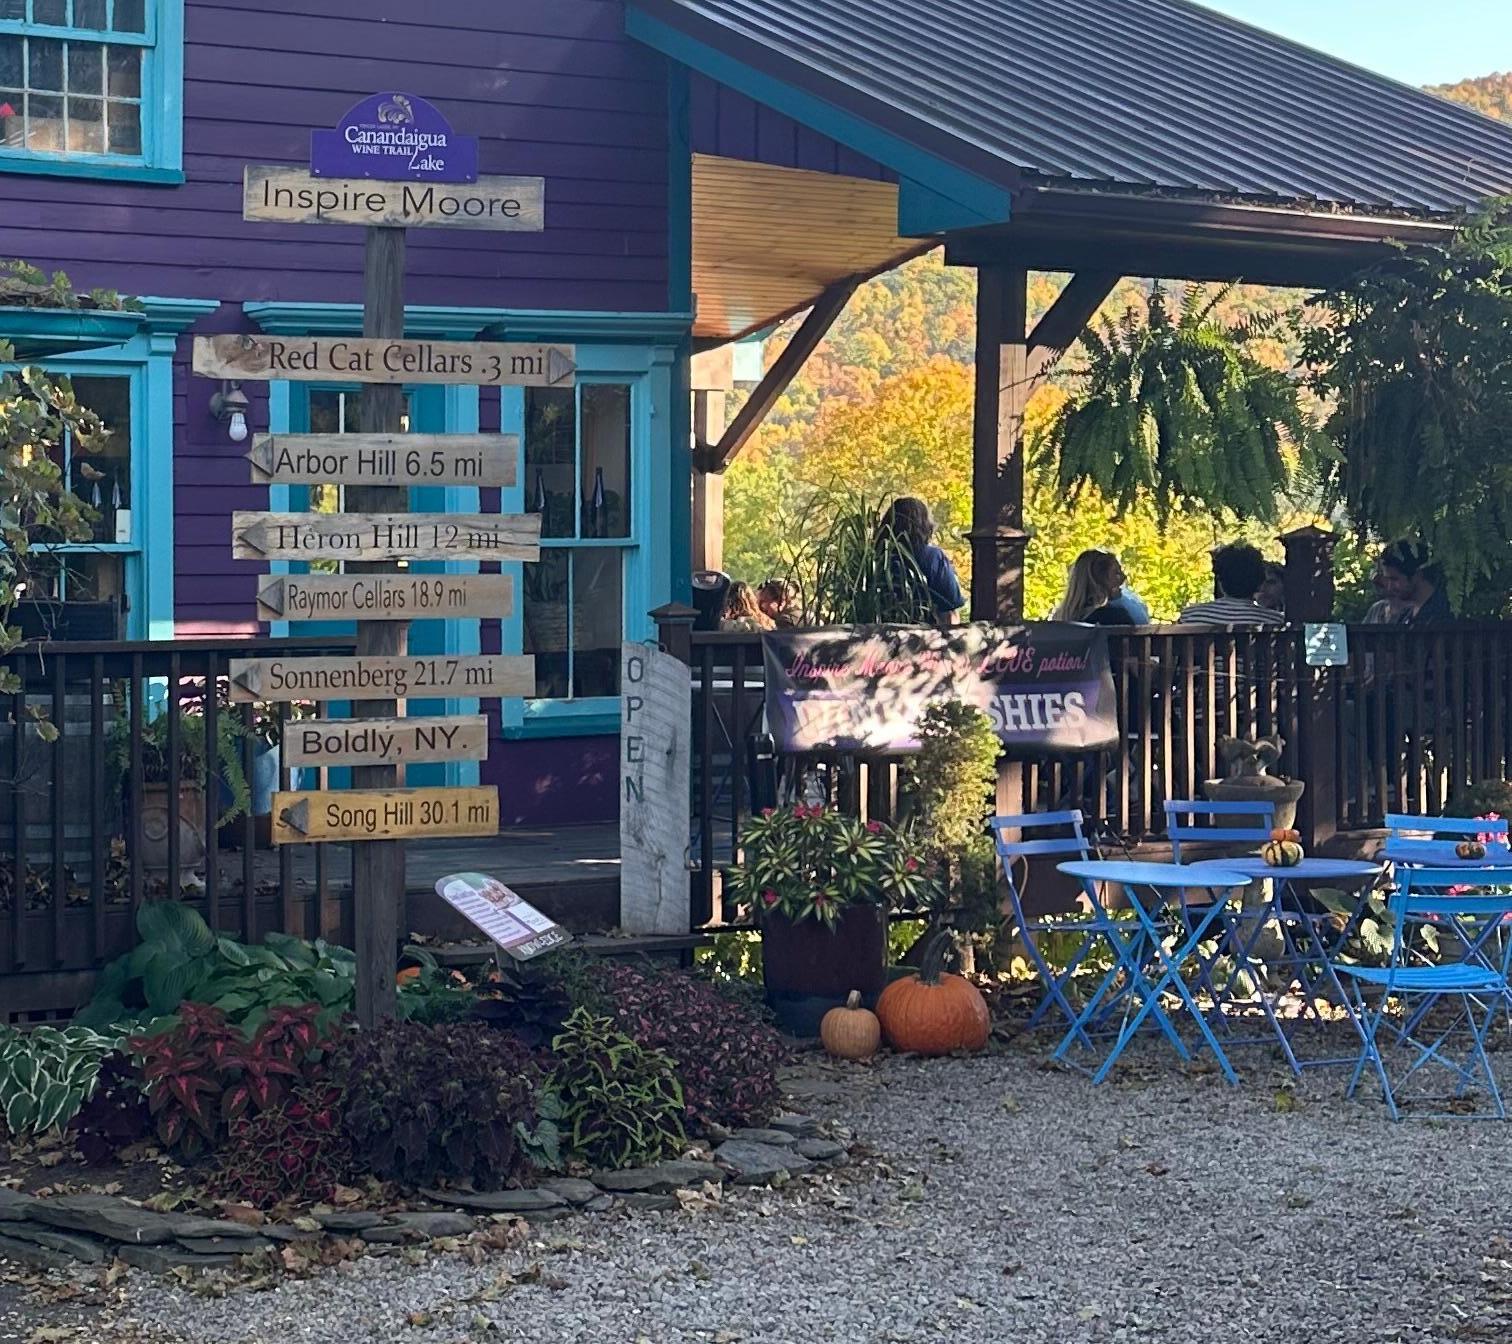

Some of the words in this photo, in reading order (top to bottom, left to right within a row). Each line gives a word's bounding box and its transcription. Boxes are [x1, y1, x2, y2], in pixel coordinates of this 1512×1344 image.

[344, 125, 448, 152] Canandaigua
[351, 143, 381, 155] WINE
[382, 145, 414, 156] TRAIL
[408, 146, 445, 171] Lake
[263, 179, 386, 215] Inspire
[401, 185, 521, 218] Moore
[269, 342, 318, 371] Red
[328, 343, 373, 372] Cat
[382, 344, 472, 374] Cellars
[480, 355, 501, 380] .3
[510, 350, 544, 376] mi
[275, 448, 348, 475] Arbor
[357, 450, 397, 476] Hill
[406, 451, 445, 477] 6.5
[454, 454, 483, 477] mi
[275, 524, 361, 551] Heron
[372, 523, 419, 550] Hill
[432, 523, 459, 549] 12
[467, 525, 500, 550] mi
[287, 584, 349, 618] Raymor
[352, 581, 405, 608] Cellars
[410, 581, 444, 607] 18.9
[448, 580, 467, 607] mi
[269, 661, 408, 696] Sonnenberg
[414, 660, 458, 687] 21.7
[464, 660, 494, 686] mi
[1036, 647, 1091, 678] potion!
[301, 727, 405, 758] Boldly,
[415, 725, 468, 751] NY.
[626, 657, 644, 803] OPEN
[326, 803, 377, 833] Song
[384, 802, 414, 827] Hill
[419, 802, 460, 826] 30.1
[467, 801, 490, 824] mi
